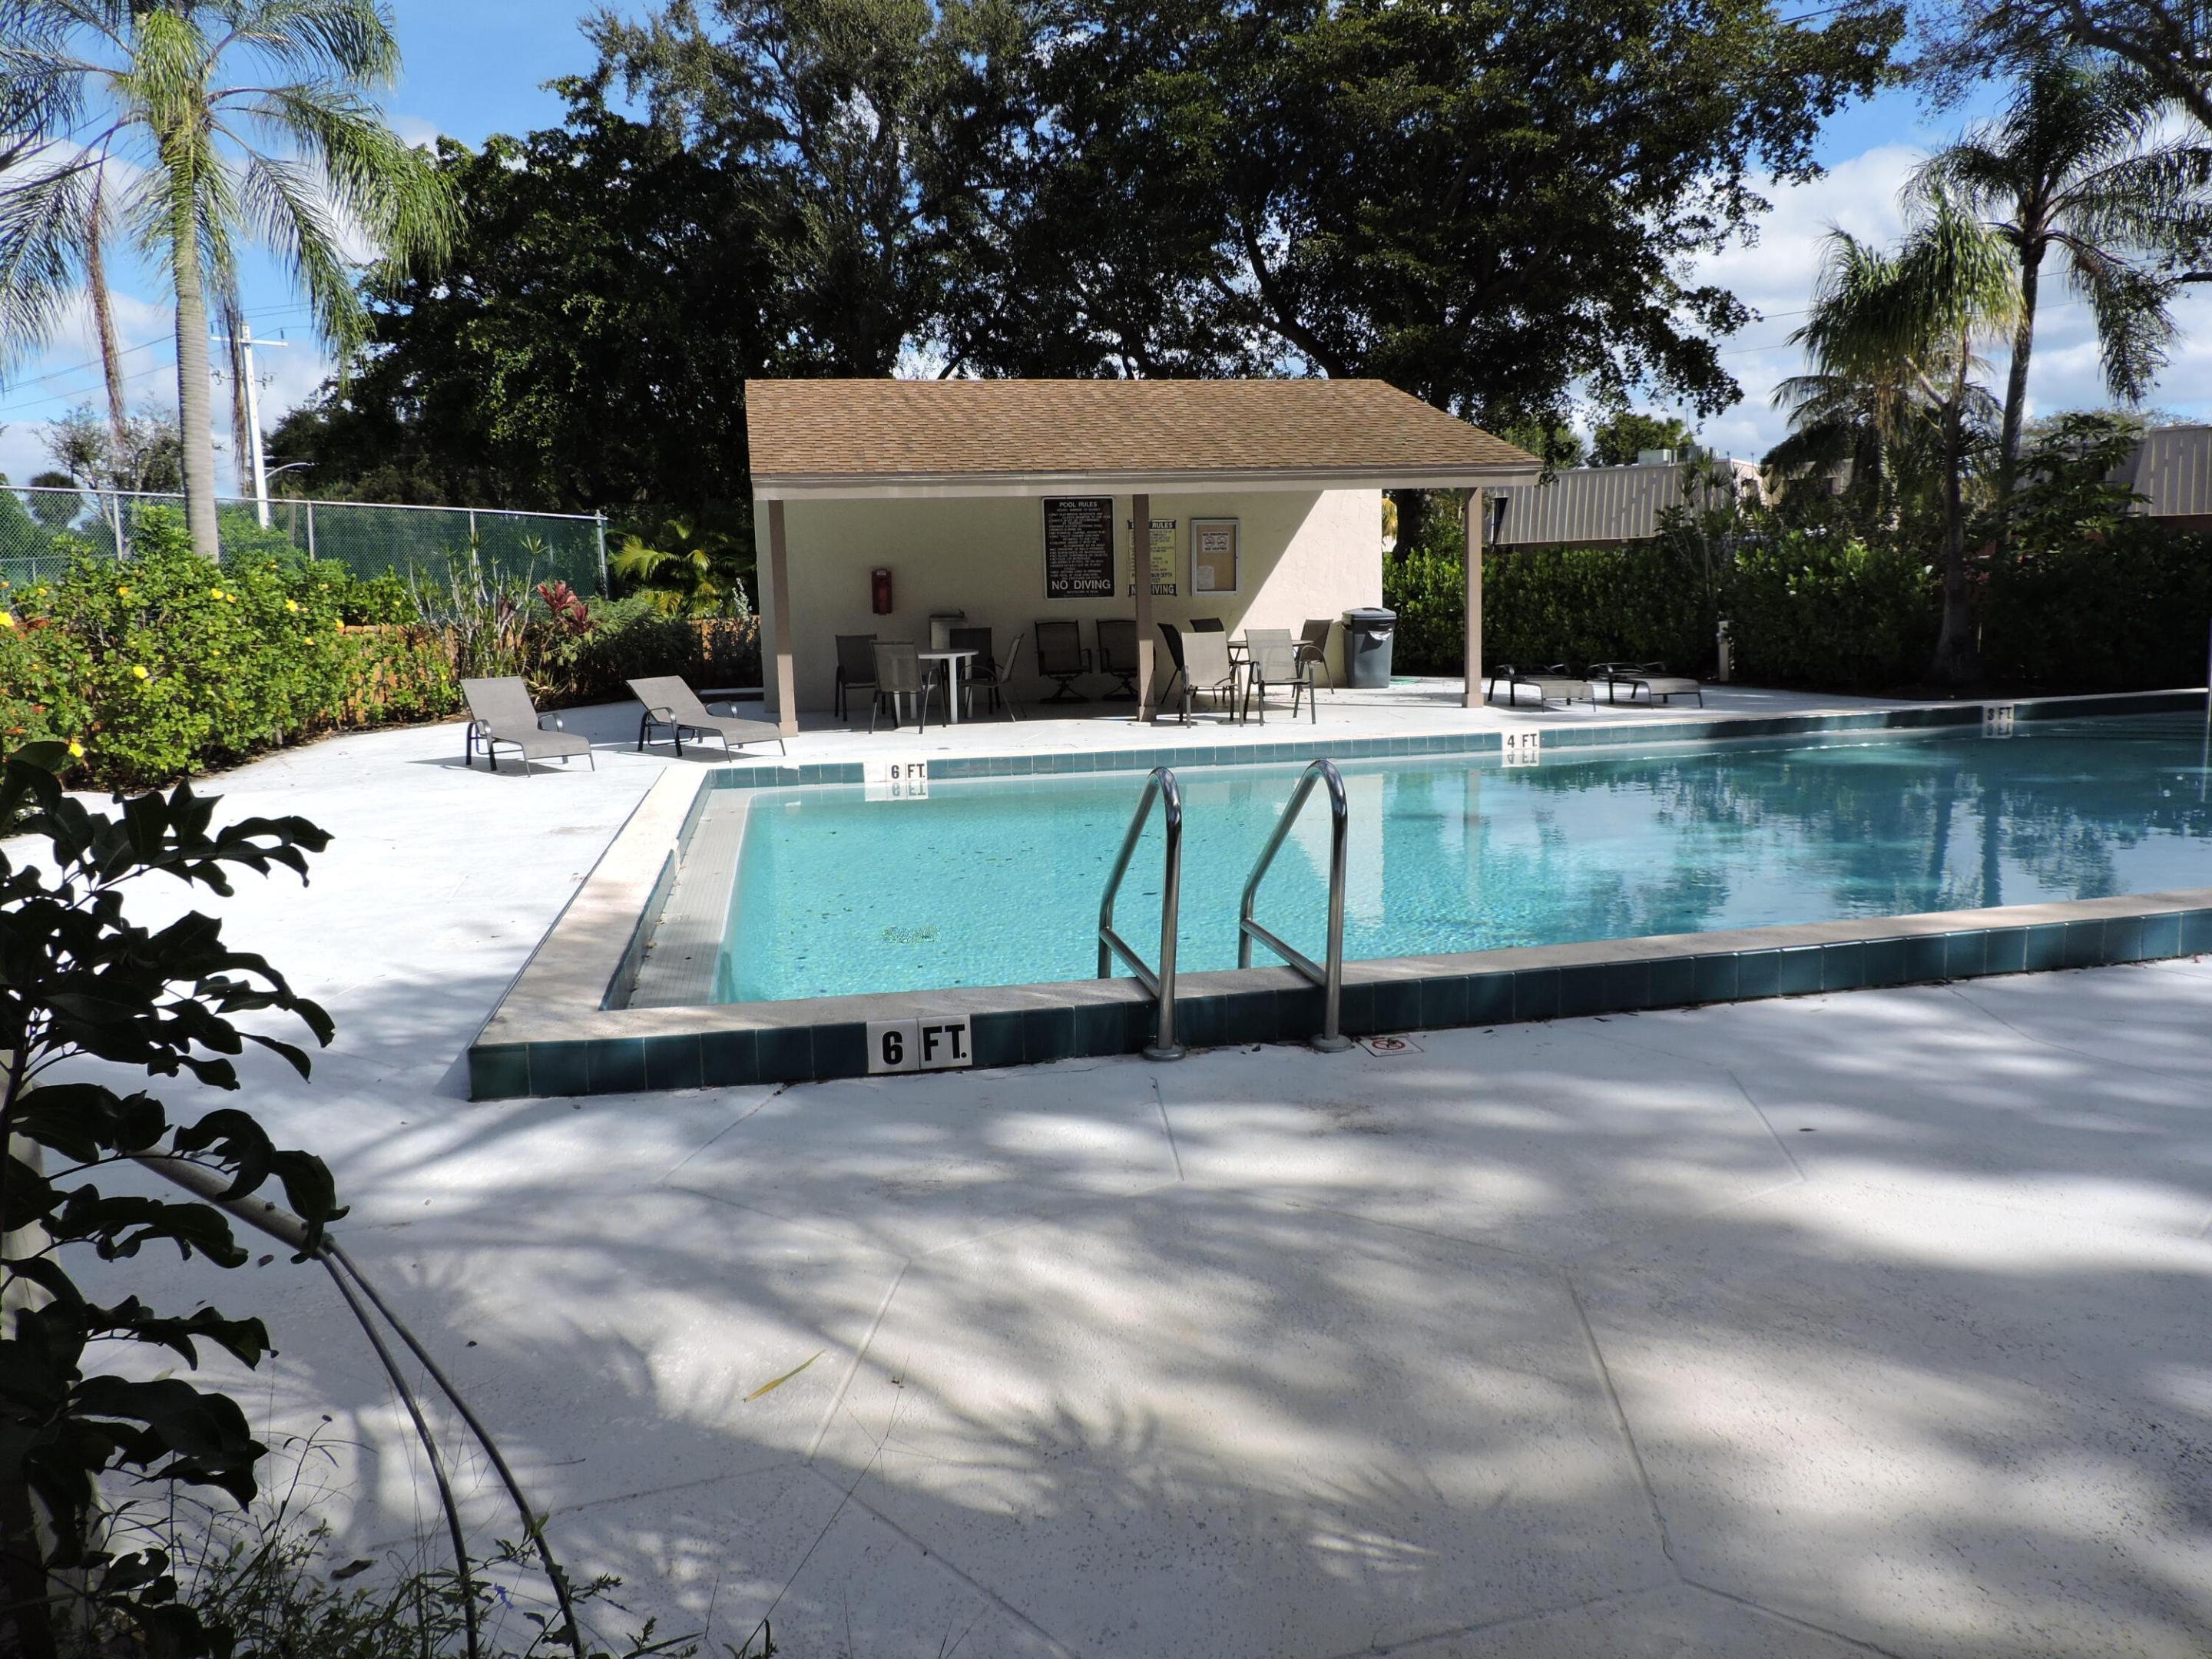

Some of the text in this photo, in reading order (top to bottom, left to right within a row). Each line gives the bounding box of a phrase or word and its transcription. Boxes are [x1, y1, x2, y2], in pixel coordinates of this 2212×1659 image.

[1051, 579, 1111, 590] NO DIVING
[1152, 584, 1174, 594] IVING
[1507, 733, 1537, 748] 4 FT.
[891, 763, 926, 779] 6 FT.
[882, 1024, 967, 1065] 6 FT.
